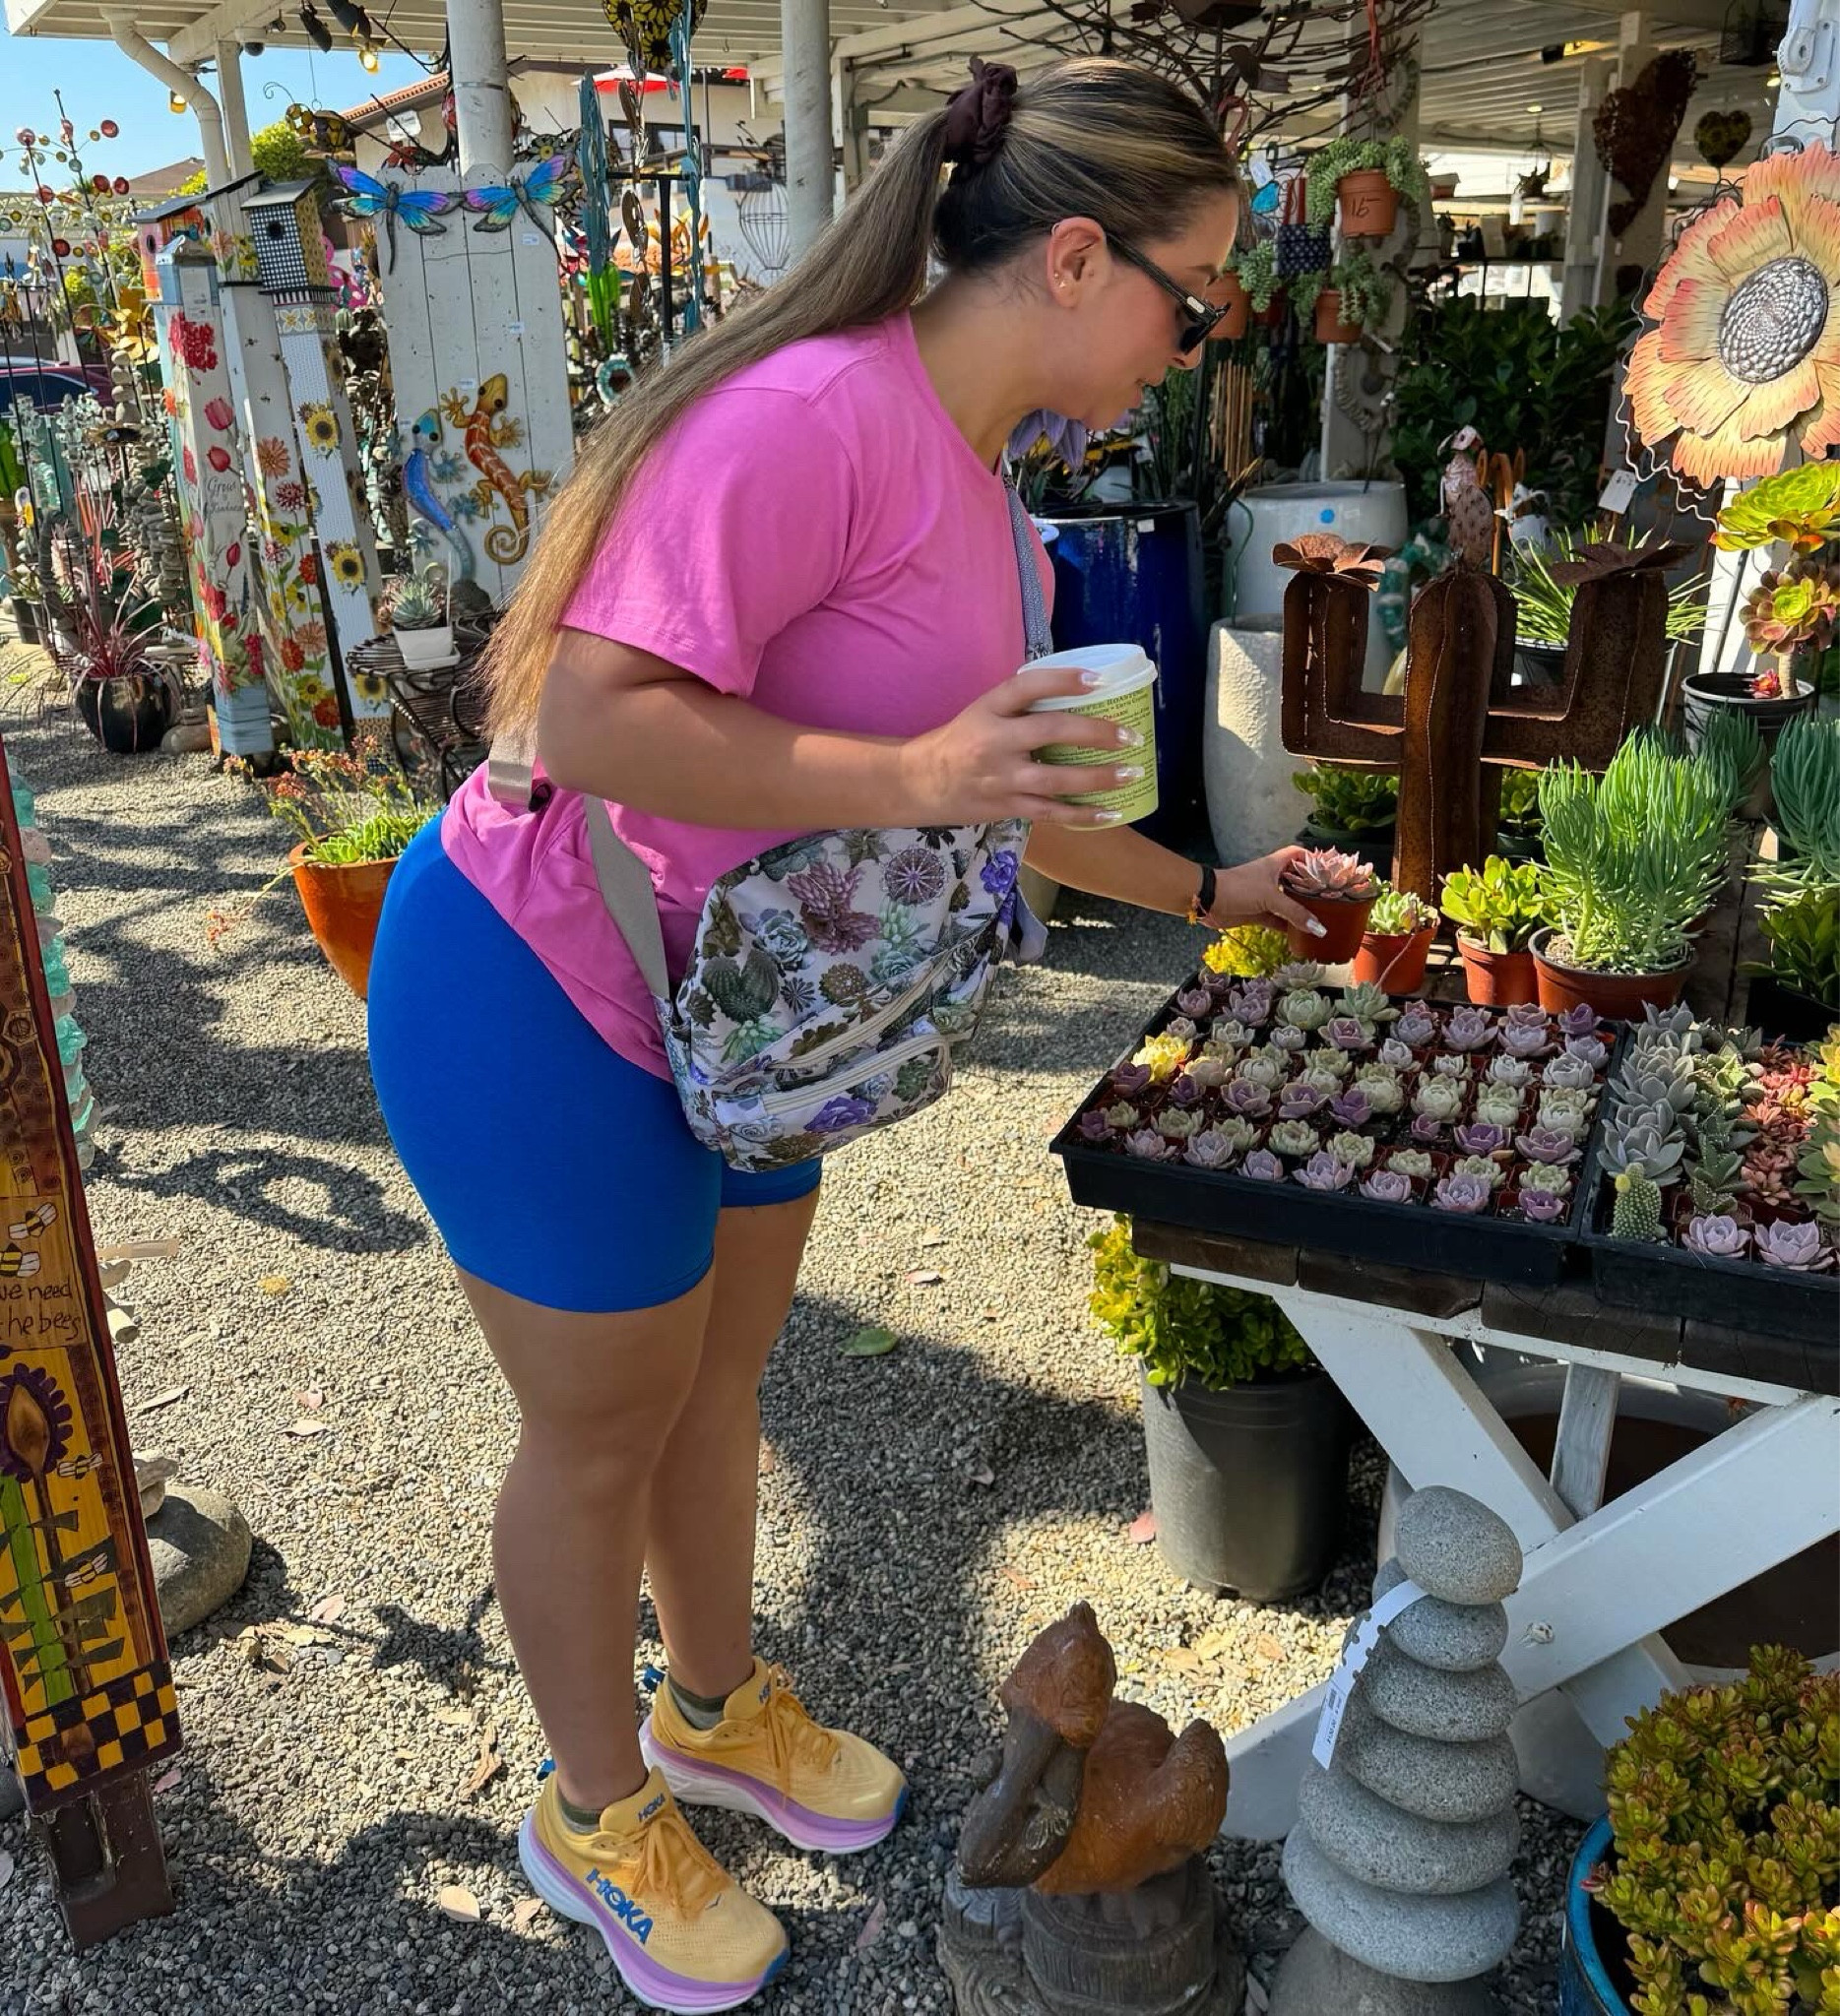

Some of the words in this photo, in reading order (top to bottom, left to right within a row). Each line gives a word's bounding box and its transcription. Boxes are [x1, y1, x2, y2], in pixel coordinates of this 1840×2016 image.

[29, 1275, 73, 1300] need
[0, 1304, 34, 1338] he
[38, 1303, 82, 1341] bees
[638, 1793, 666, 1822] HOKA
[585, 1868, 654, 1944] HOKA
